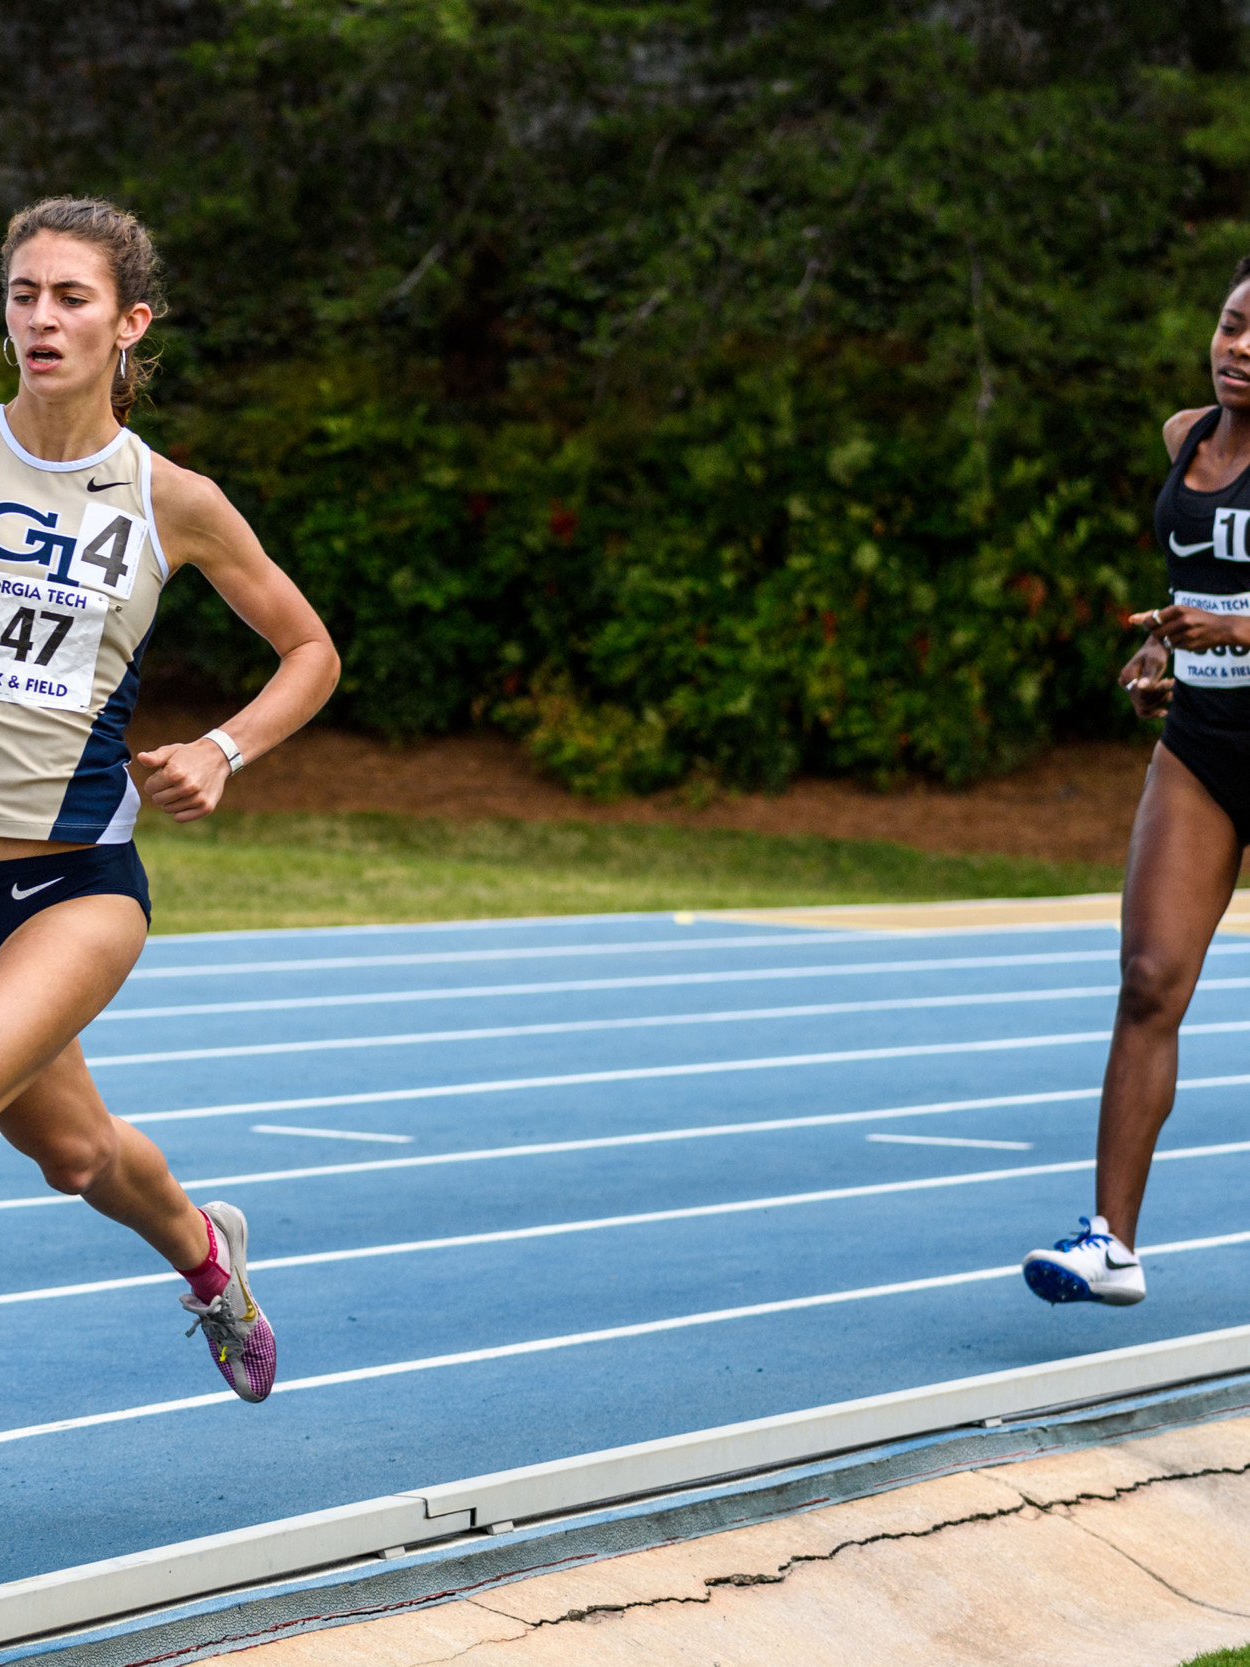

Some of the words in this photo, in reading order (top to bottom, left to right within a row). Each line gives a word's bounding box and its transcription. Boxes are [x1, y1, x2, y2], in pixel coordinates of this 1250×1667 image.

[1220, 512, 1250, 558] 1
[81, 514, 133, 588] 4
[48, 589, 87, 609] TECH
[1182, 597, 1218, 610] GEORGIA
[1221, 600, 1249, 611] TECH
[1187, 666, 1218, 678] TRACK
[1221, 667, 1229, 678] &
[8, 675, 20, 690] &
[25, 678, 68, 697] FIELD
